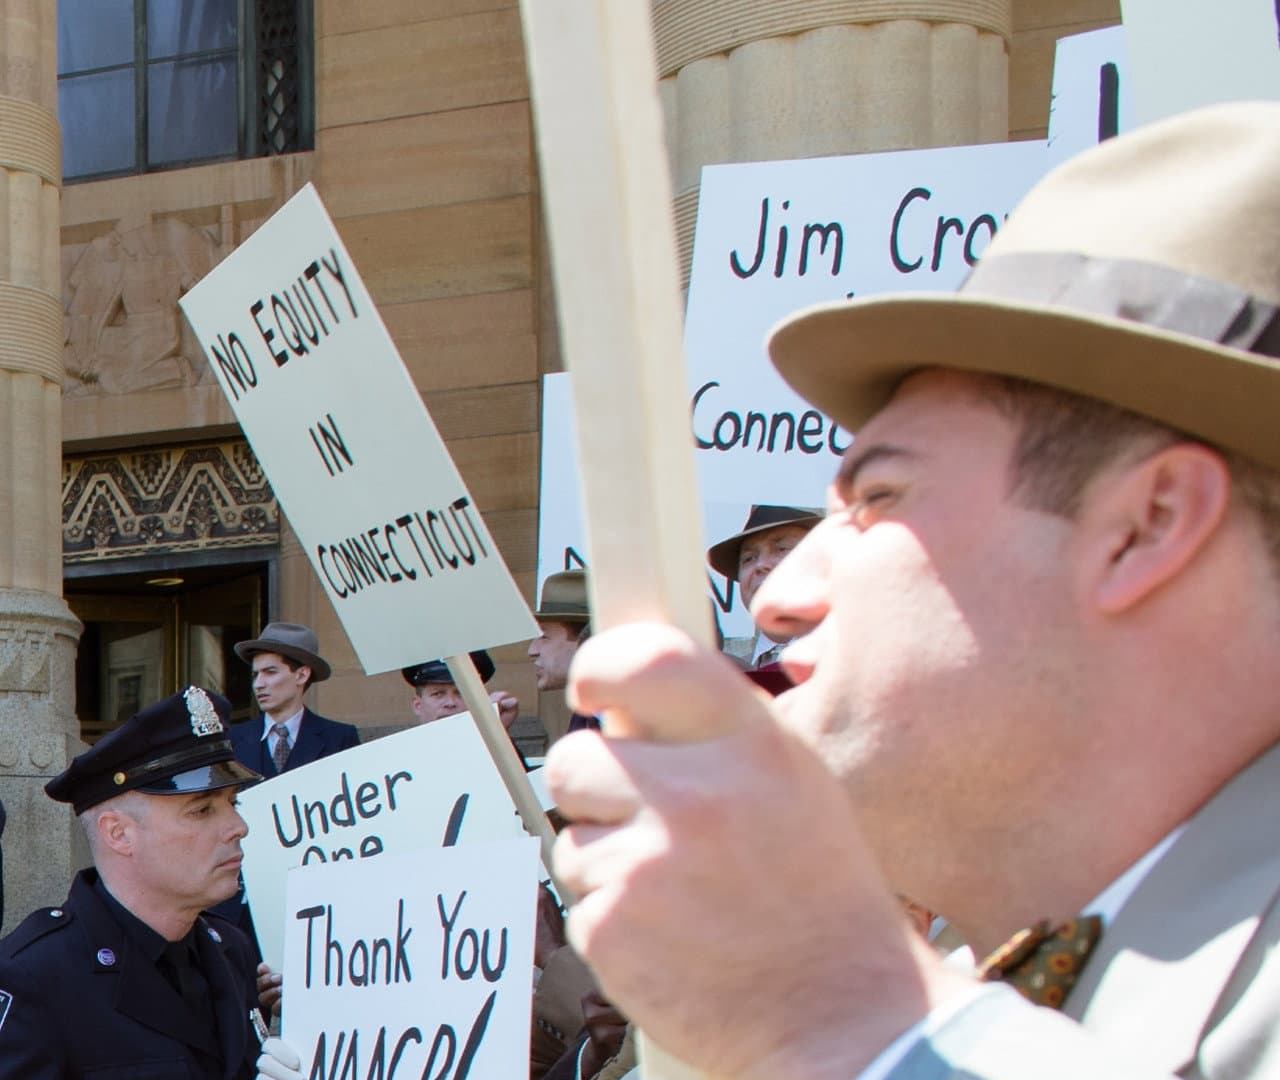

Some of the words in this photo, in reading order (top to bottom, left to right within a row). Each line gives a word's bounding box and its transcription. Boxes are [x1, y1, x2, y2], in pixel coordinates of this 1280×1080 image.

[730, 197, 844, 279] Jim
[890, 187, 1008, 274] Cro
[210, 331, 258, 400] NO
[250, 249, 359, 369] EQUITY
[308, 413, 354, 476] IN
[691, 381, 847, 457] Connec
[317, 497, 488, 600] CONNECTICUT
[271, 771, 413, 849] Under
[296, 898, 412, 989] Thank
[437, 890, 508, 983] You
